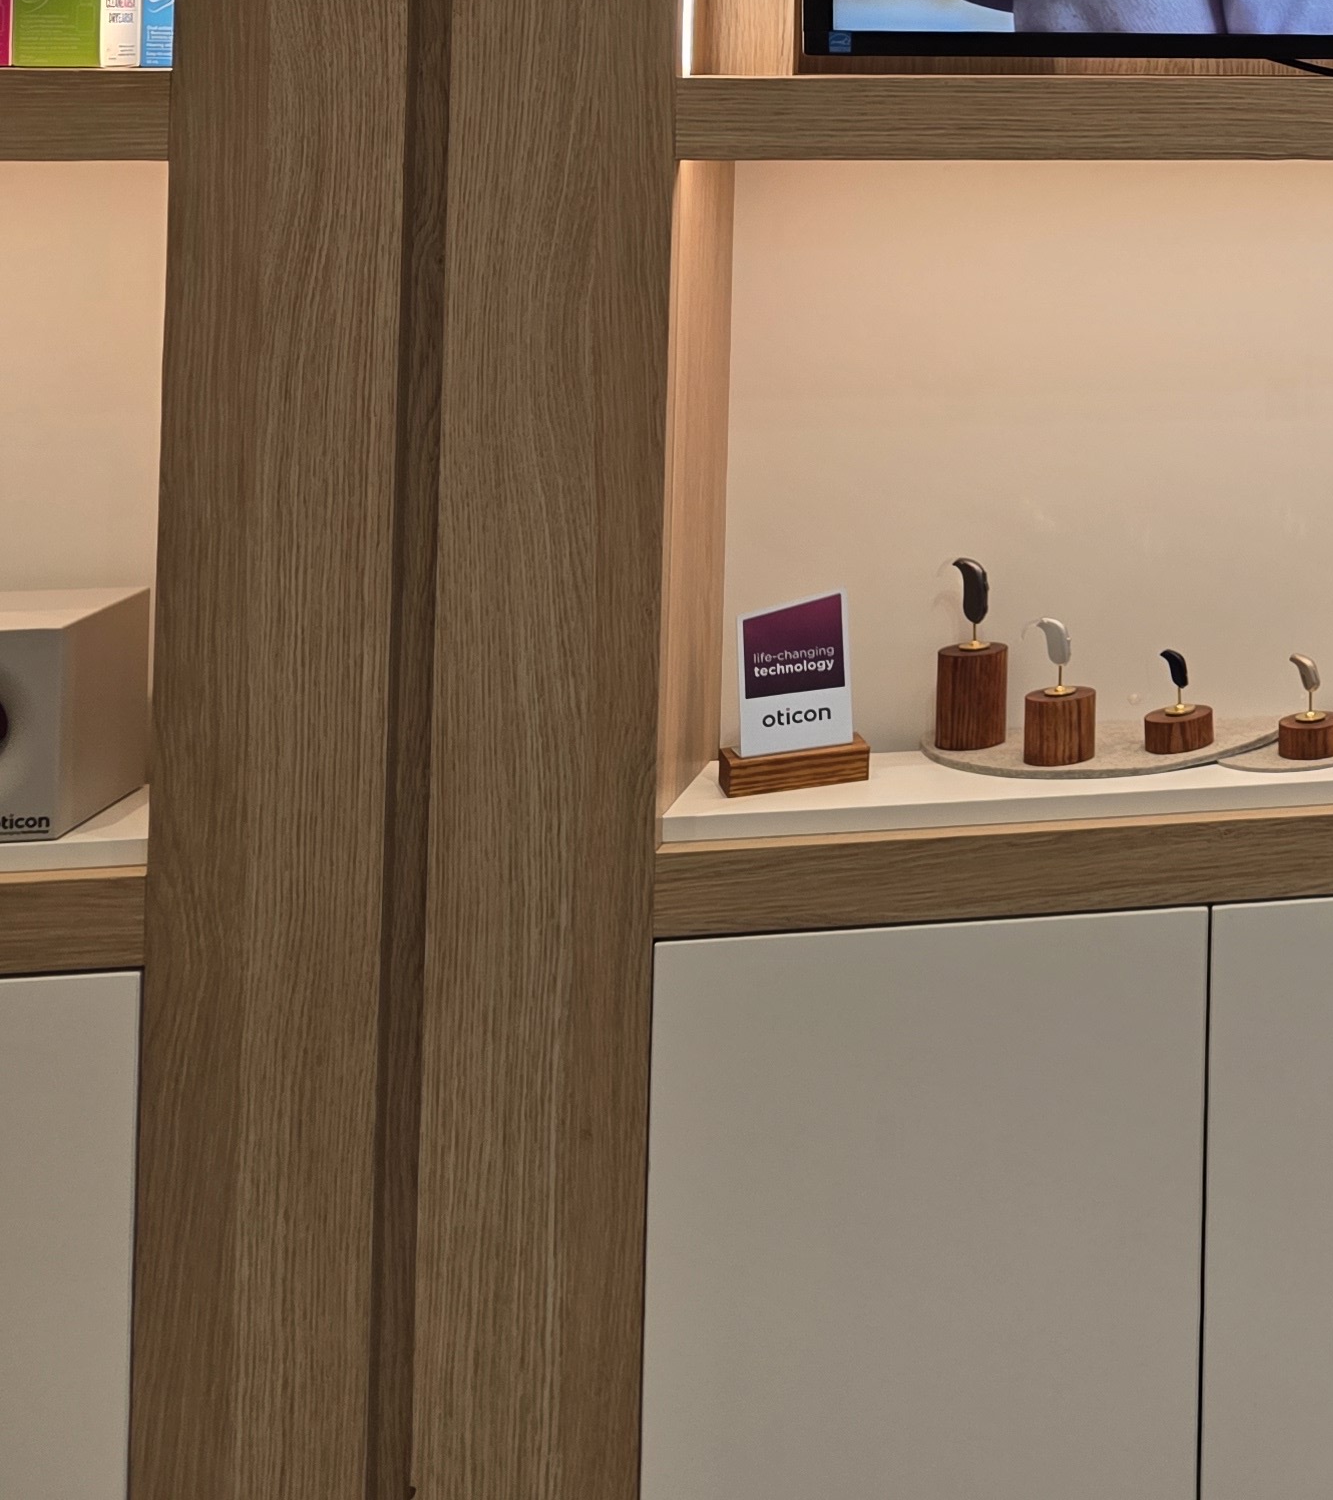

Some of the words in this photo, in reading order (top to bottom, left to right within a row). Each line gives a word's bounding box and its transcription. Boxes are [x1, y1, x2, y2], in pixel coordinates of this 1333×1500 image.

[753, 646, 835, 664] life-changing
[754, 659, 834, 678] technology
[762, 707, 832, 728] oticon
[0, 813, 50, 830] ticon
